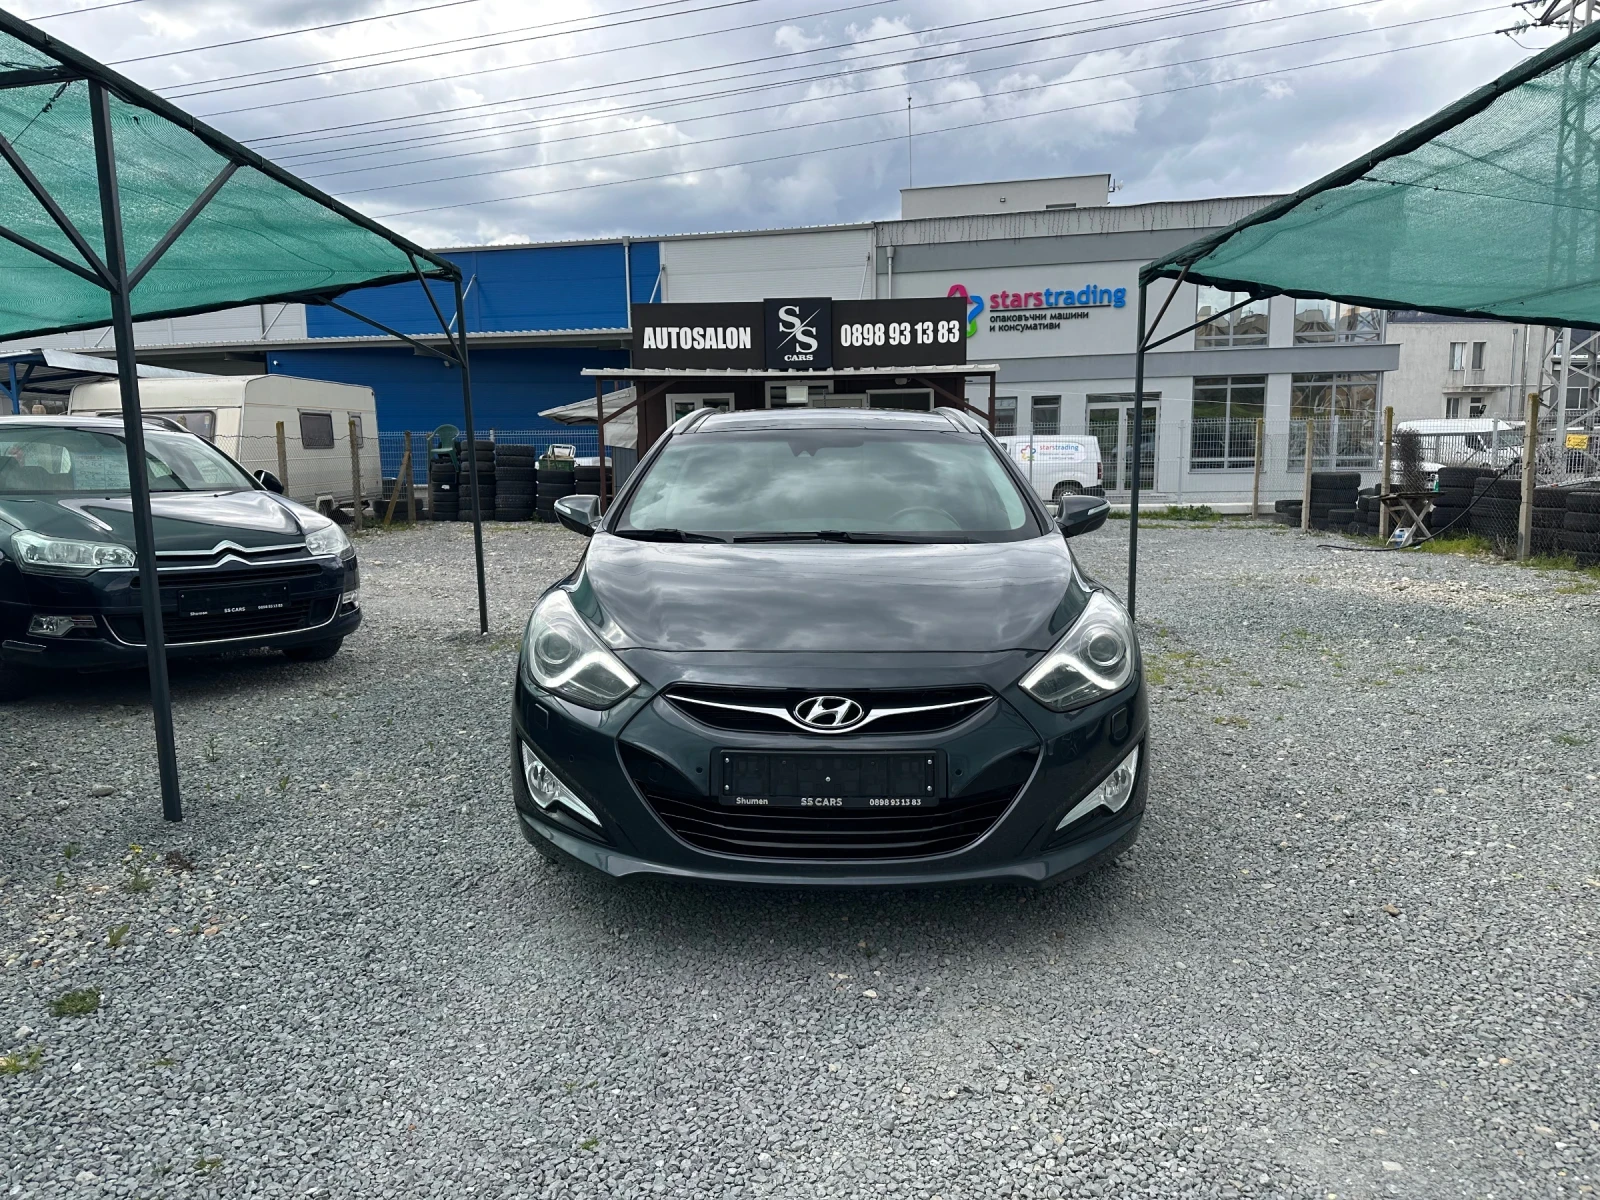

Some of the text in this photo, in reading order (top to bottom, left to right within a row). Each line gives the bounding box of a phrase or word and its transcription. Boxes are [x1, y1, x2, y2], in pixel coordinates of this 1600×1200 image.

[989, 284, 1126, 308] starstrading
[989, 311, 1089, 323] опаковъчни машини
[998, 322, 1060, 333] консумативи
[643, 327, 751, 349] AUTOSALON
[840, 320, 960, 347] 0898 93 13 83
[784, 354, 813, 362] CARS
[1039, 444, 1079, 452] starstrading
[736, 797, 768, 805] Shumen
[801, 798, 814, 806] SS
[815, 798, 843, 806] CARS
